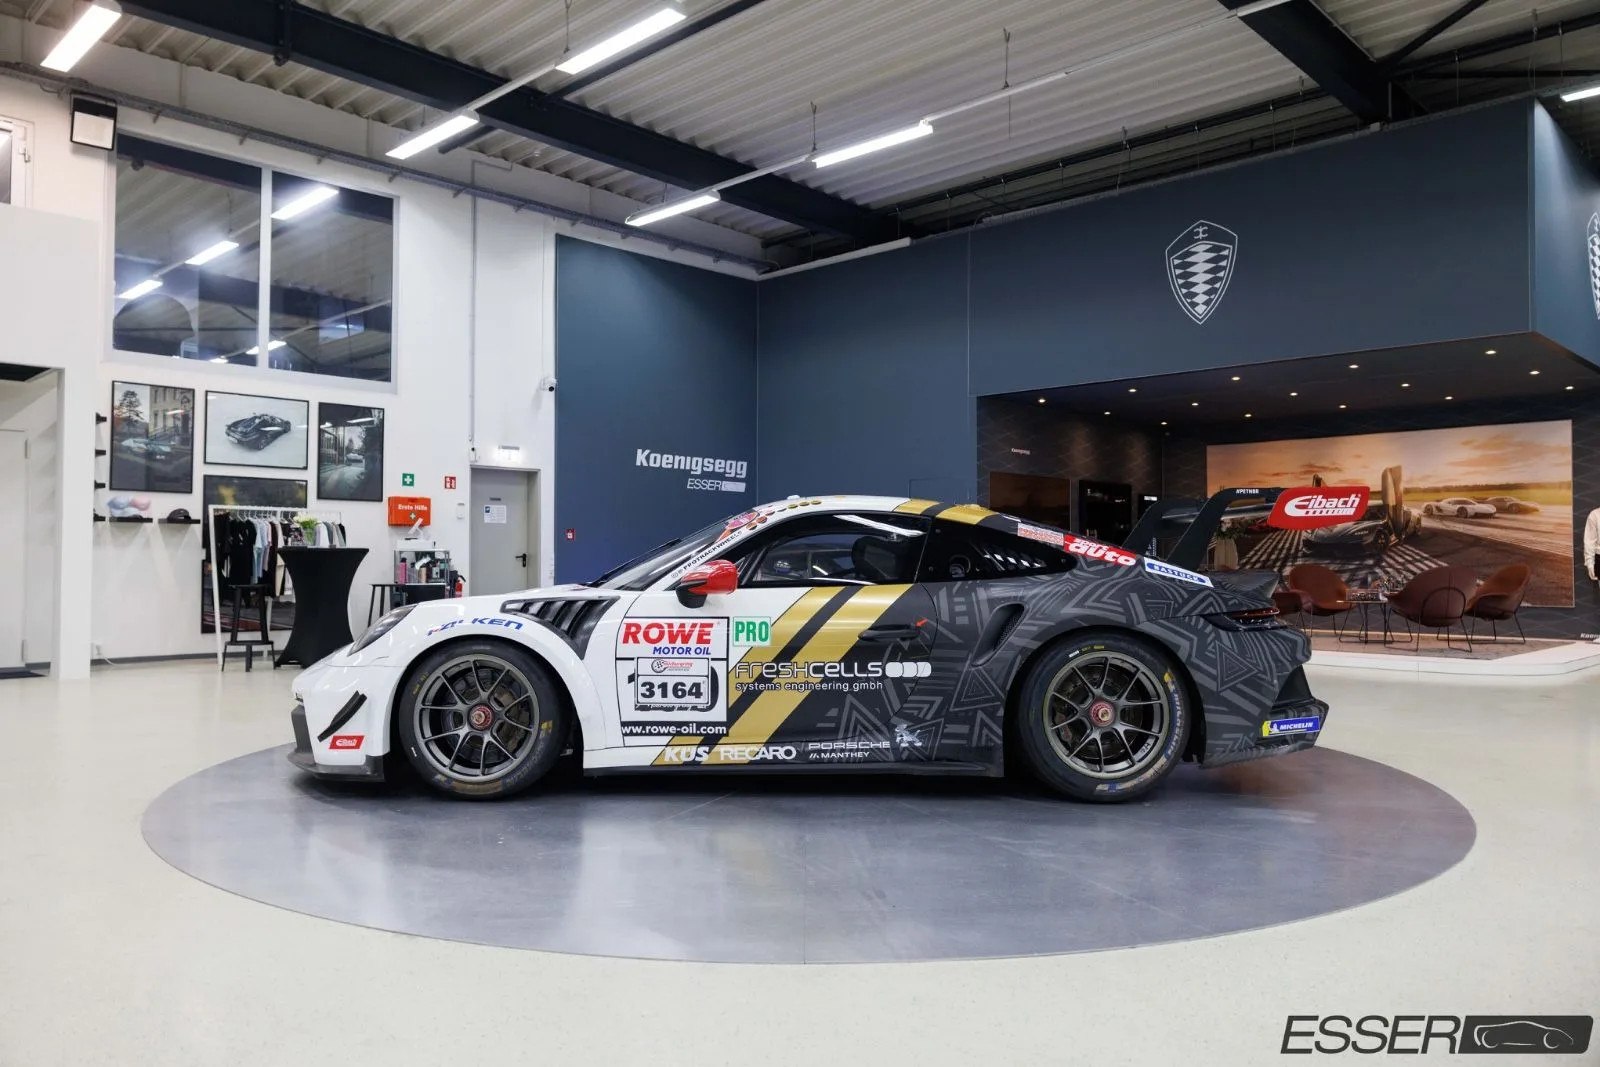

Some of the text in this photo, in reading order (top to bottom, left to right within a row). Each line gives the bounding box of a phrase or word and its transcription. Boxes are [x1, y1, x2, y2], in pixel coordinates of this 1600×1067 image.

[636, 448, 747, 478] Koenigsegg
[687, 478, 721, 491] ESSER
[1284, 494, 1361, 517] Eibach
[1068, 542, 1136, 566] auto
[1153, 564, 1199, 582] BASTUCK
[622, 622, 714, 645] ROWE
[735, 621, 769, 642] PRO
[652, 647, 712, 656] MOTOR OIL
[640, 681, 703, 699] 3164
[736, 681, 883, 692] systems engineering gmbh
[1280, 722, 1314, 730] MICHELIN
[720, 746, 797, 761] RECARO
[808, 741, 891, 750] PORSCHE
[821, 751, 870, 759] MANTHEY
